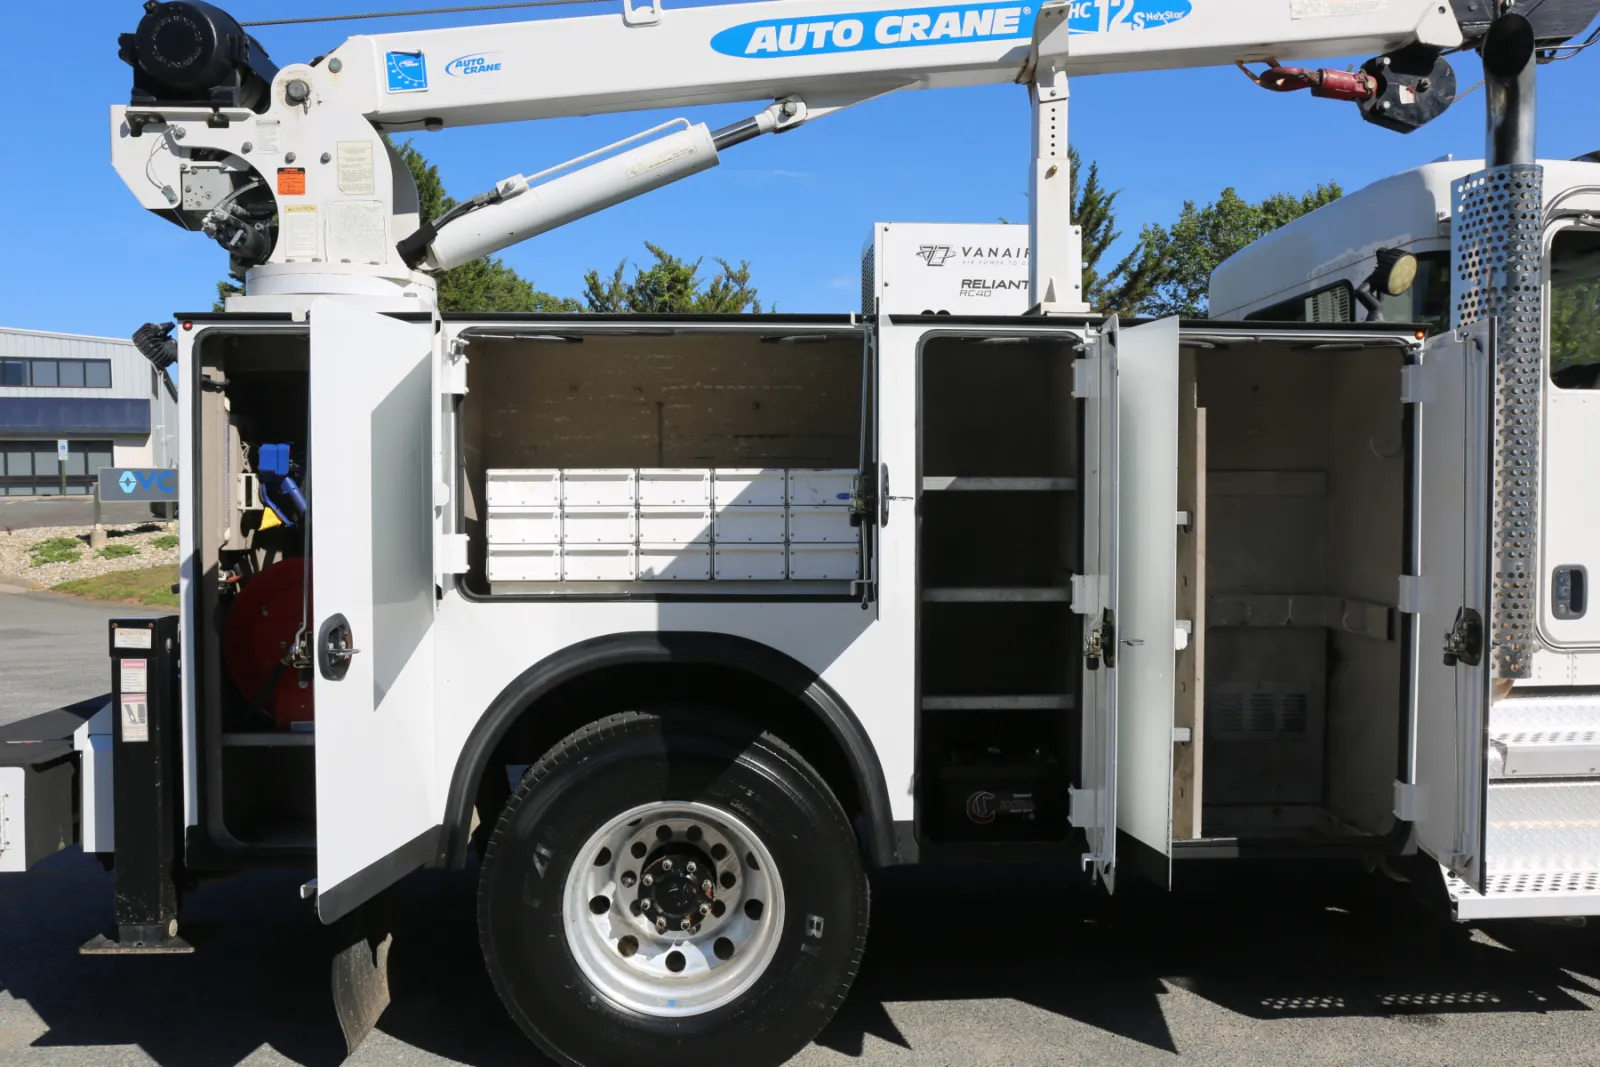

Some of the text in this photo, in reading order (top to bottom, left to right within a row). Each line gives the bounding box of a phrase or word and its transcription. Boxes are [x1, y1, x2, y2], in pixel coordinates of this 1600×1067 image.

[1068, 2, 1092, 19] HC
[1094, 0, 1133, 33] 12
[1146, 10, 1185, 24] NexStar
[744, 19, 864, 54] AUTO
[455, 57, 485, 68] AUTO
[463, 63, 502, 75] CRANE
[962, 279, 1029, 289] RELIANT
